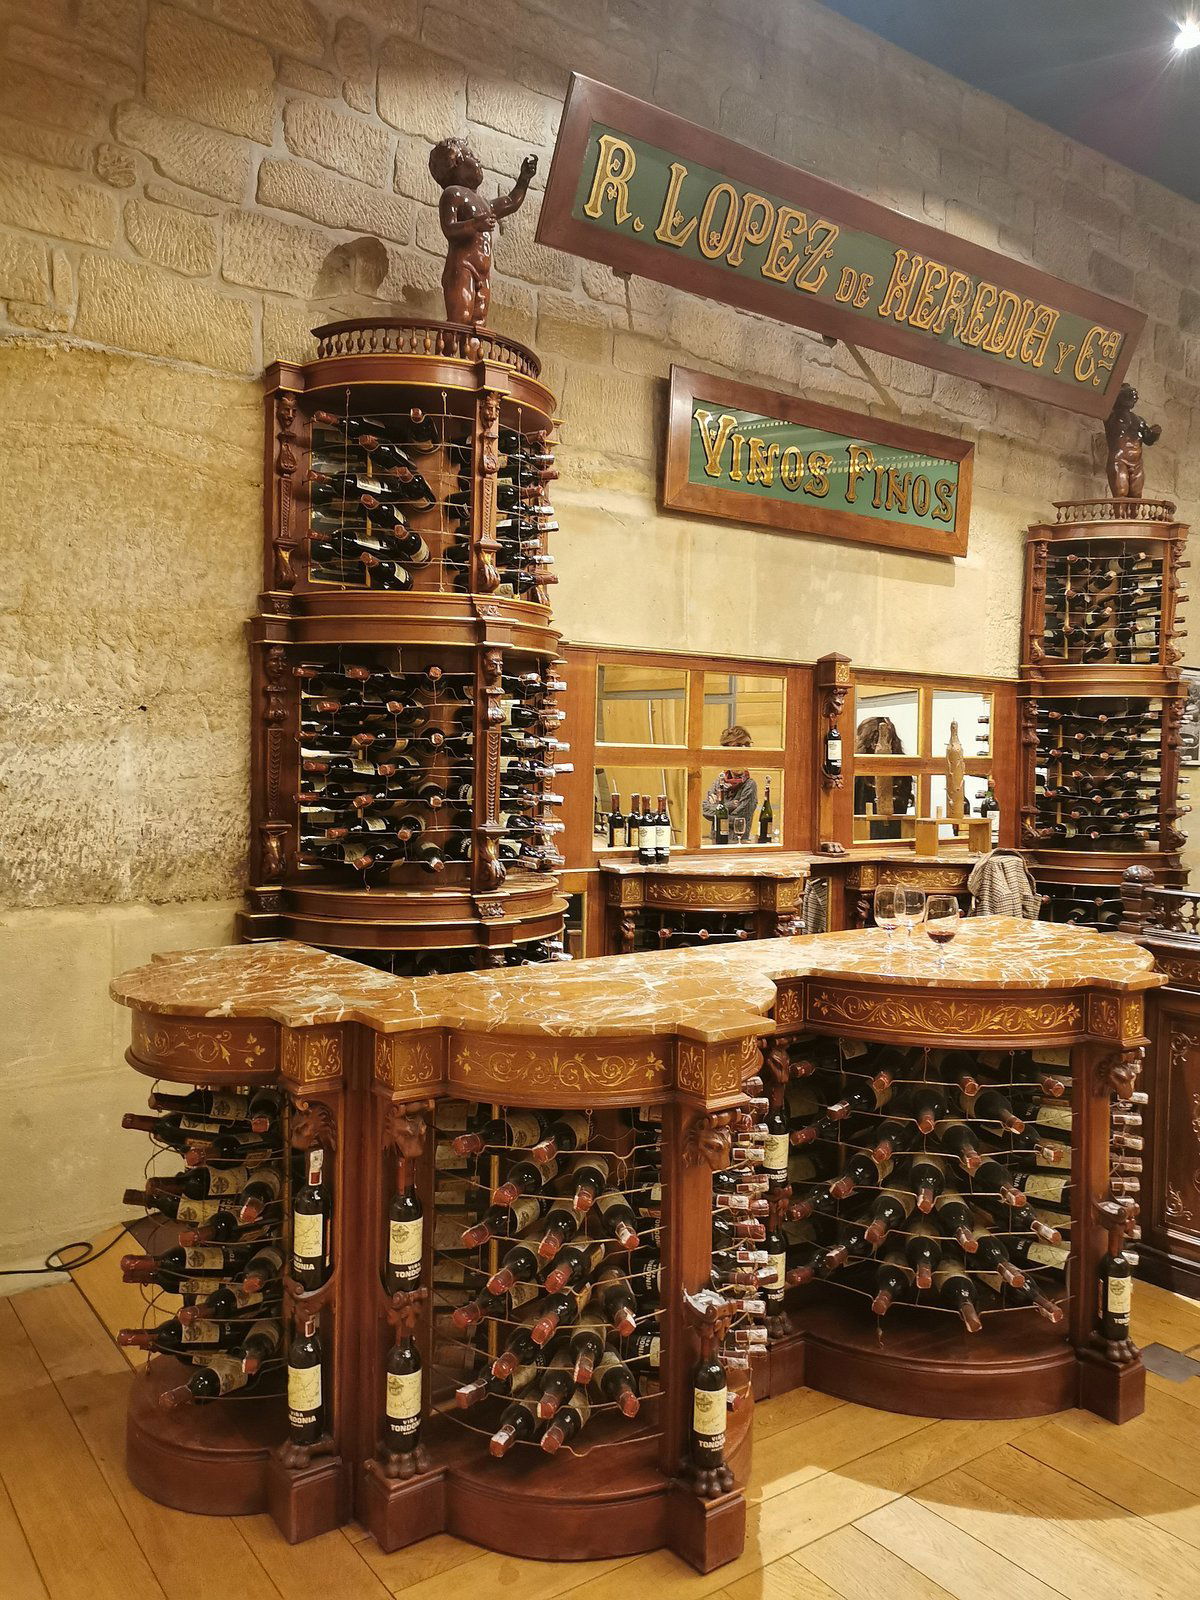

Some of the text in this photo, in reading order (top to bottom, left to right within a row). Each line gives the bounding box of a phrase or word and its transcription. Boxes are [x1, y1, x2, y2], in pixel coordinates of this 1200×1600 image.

[582, 133, 645, 233] R.
[654, 161, 840, 293] LOPEZ
[834, 266, 875, 309] DE
[877, 249, 1061, 368] HEREDIA
[1053, 341, 1076, 375] Y
[692, 408, 957, 523] VINOS FINOS
